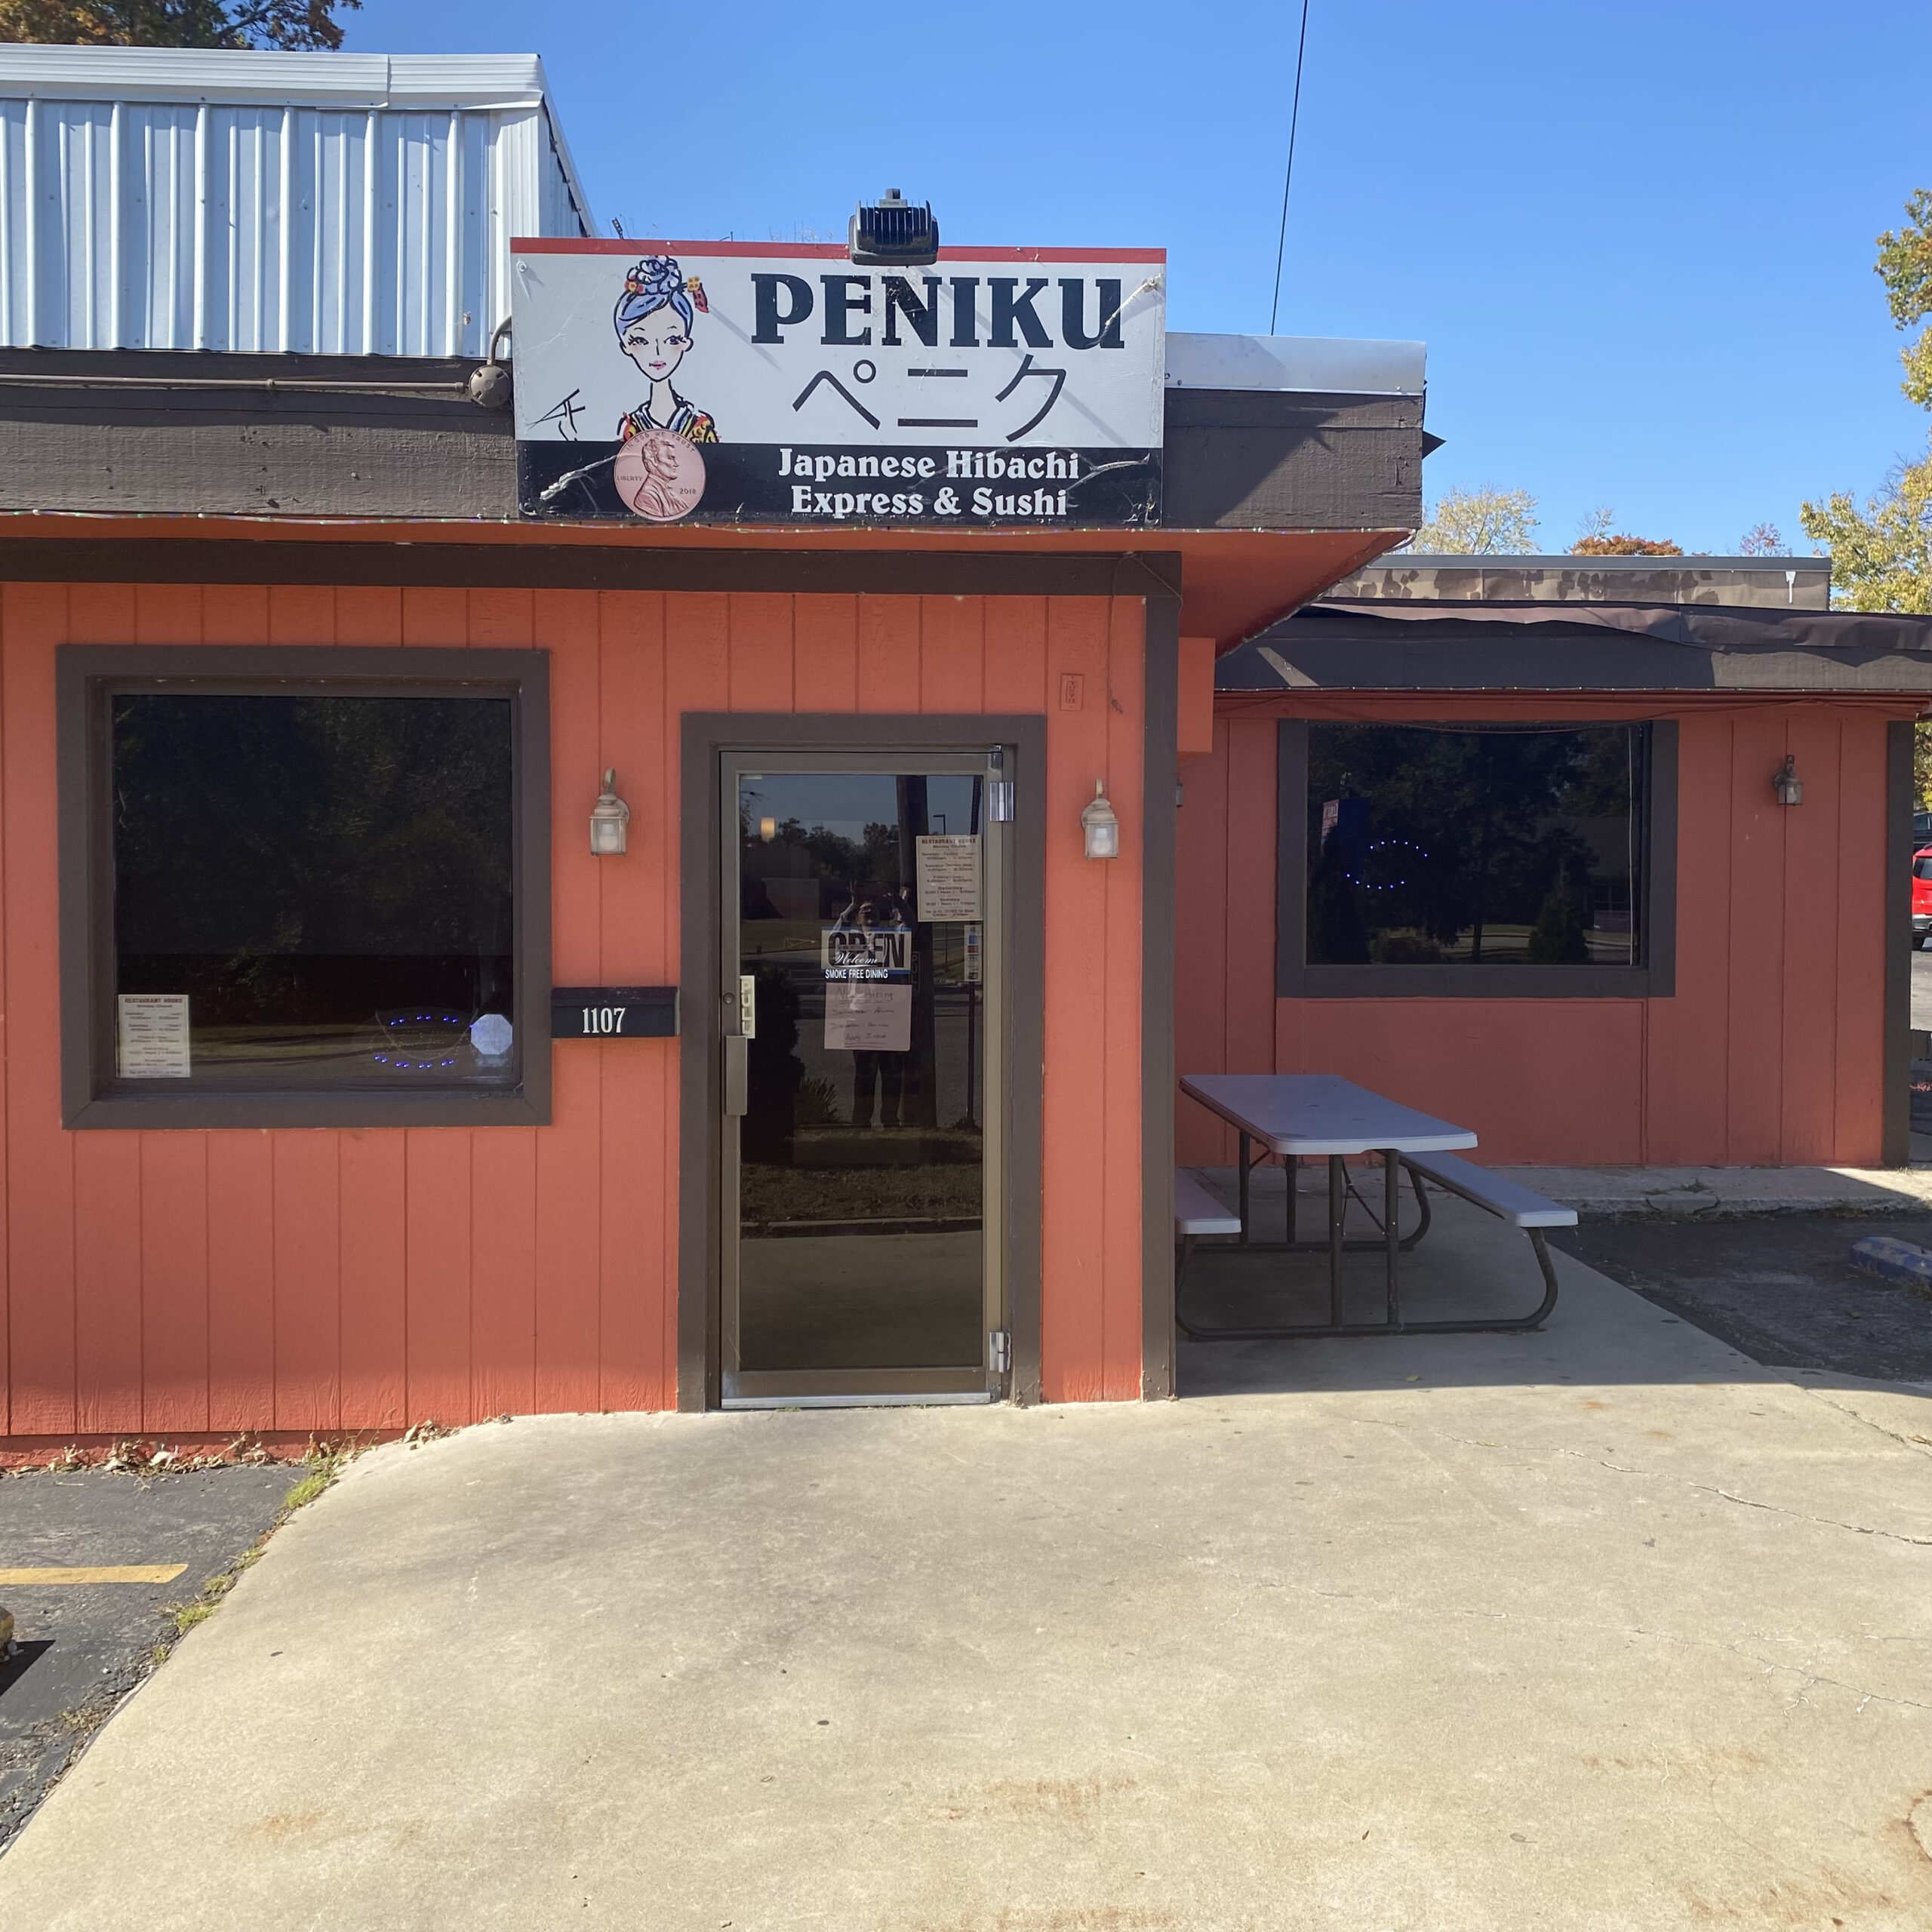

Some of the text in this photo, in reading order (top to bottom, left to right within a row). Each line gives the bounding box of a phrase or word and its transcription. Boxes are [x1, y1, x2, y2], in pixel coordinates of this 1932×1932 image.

[751, 272, 1124, 349] PENIKU
[793, 354, 1066, 441] ペニク
[635, 432, 650, 443] GOD
[672, 434, 696, 452] TRUST
[778, 448, 1080, 481] Japanese Hibachi
[791, 485, 1067, 518] Express & Sushi
[828, 931, 905, 968] OPEN
[834, 951, 878, 965] Welcome
[825, 969, 888, 979] SMOKE FREE DINING
[582, 1008, 626, 1034] 1107
[741, 980, 752, 1035] PULL
